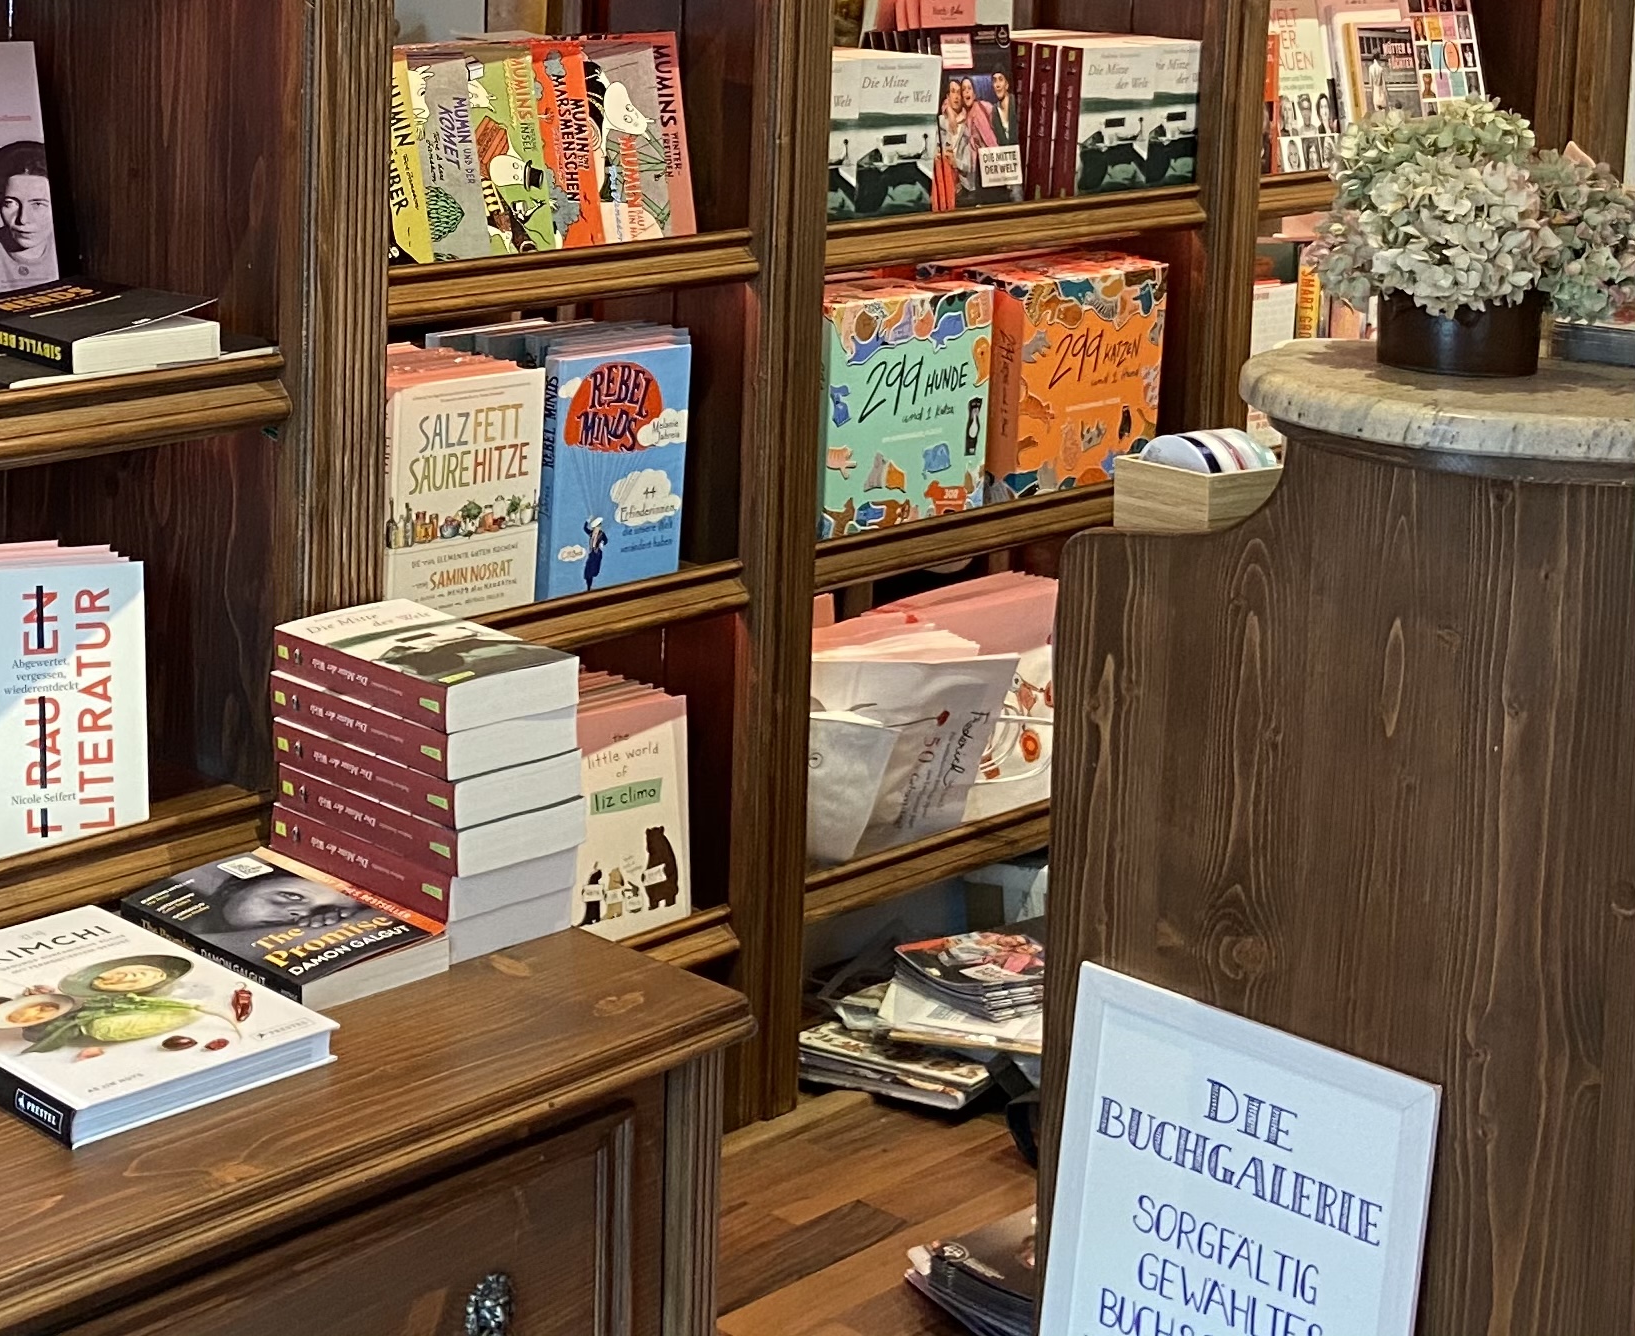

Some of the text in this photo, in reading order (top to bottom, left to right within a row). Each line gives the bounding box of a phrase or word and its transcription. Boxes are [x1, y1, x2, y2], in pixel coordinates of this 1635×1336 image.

[651, 44, 678, 128] MUMINS
[861, 75, 910, 90] Die Mitte
[893, 90, 933, 105] der Welt
[437, 103, 461, 171] KOMET
[452, 96, 473, 144] MUMIN
[551, 74, 582, 203] MARSMENSCHEN
[18, 338, 62, 362] SIBYLLE
[1048, 327, 1143, 390] 299 KATZEN
[586, 364, 654, 421] REBEL
[857, 354, 969, 424] 299 HUNDE
[419, 402, 524, 454] SALZ FETT
[576, 408, 640, 453] MINDS
[408, 441, 530, 496] SÄURE HITZE
[429, 558, 514, 592] SAMIN NOSRAT
[306, 613, 379, 635] Die Mitte
[372, 618, 395, 628] der
[11, 657, 71, 670] Abgewertet,
[16, 670, 67, 681] vergessen,
[4, 681, 79, 695] wiederentdeckt
[74, 587, 116, 830] LITERATUR
[587, 741, 660, 769] little world
[616, 764, 629, 778] of
[11, 791, 77, 806] Nicole Seifert
[594, 786, 657, 813] liz climo
[252, 925, 307, 951] The
[263, 914, 394, 969] Promise
[287, 923, 411, 976] DAMON GALGUT
[25, 1100, 59, 1126] PRESTEL
[1202, 1076, 1300, 1153] DIE
[1095, 1095, 1385, 1248] BUCHGALERIE
[1132, 1193, 1321, 1306] SORGFÄLTIG
